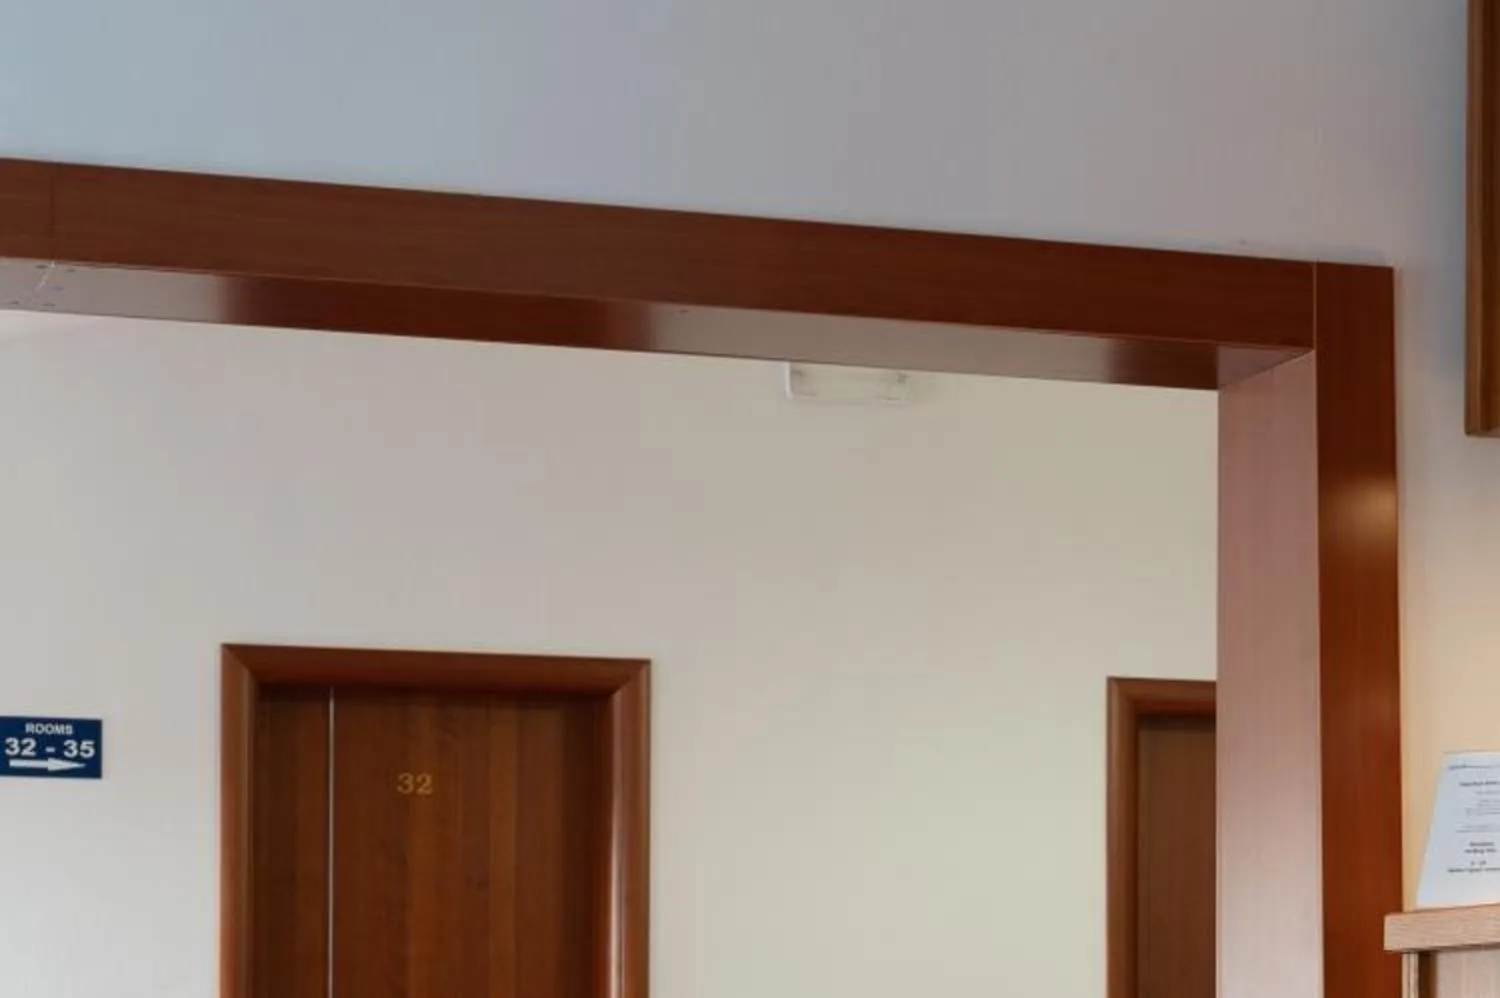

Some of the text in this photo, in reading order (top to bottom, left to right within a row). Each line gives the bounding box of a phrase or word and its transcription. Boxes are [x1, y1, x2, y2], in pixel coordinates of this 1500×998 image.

[25, 722, 73, 734] ROOMS
[5, 737, 37, 756] 32
[63, 739, 95, 758] 35
[397, 772, 433, 795] 32
